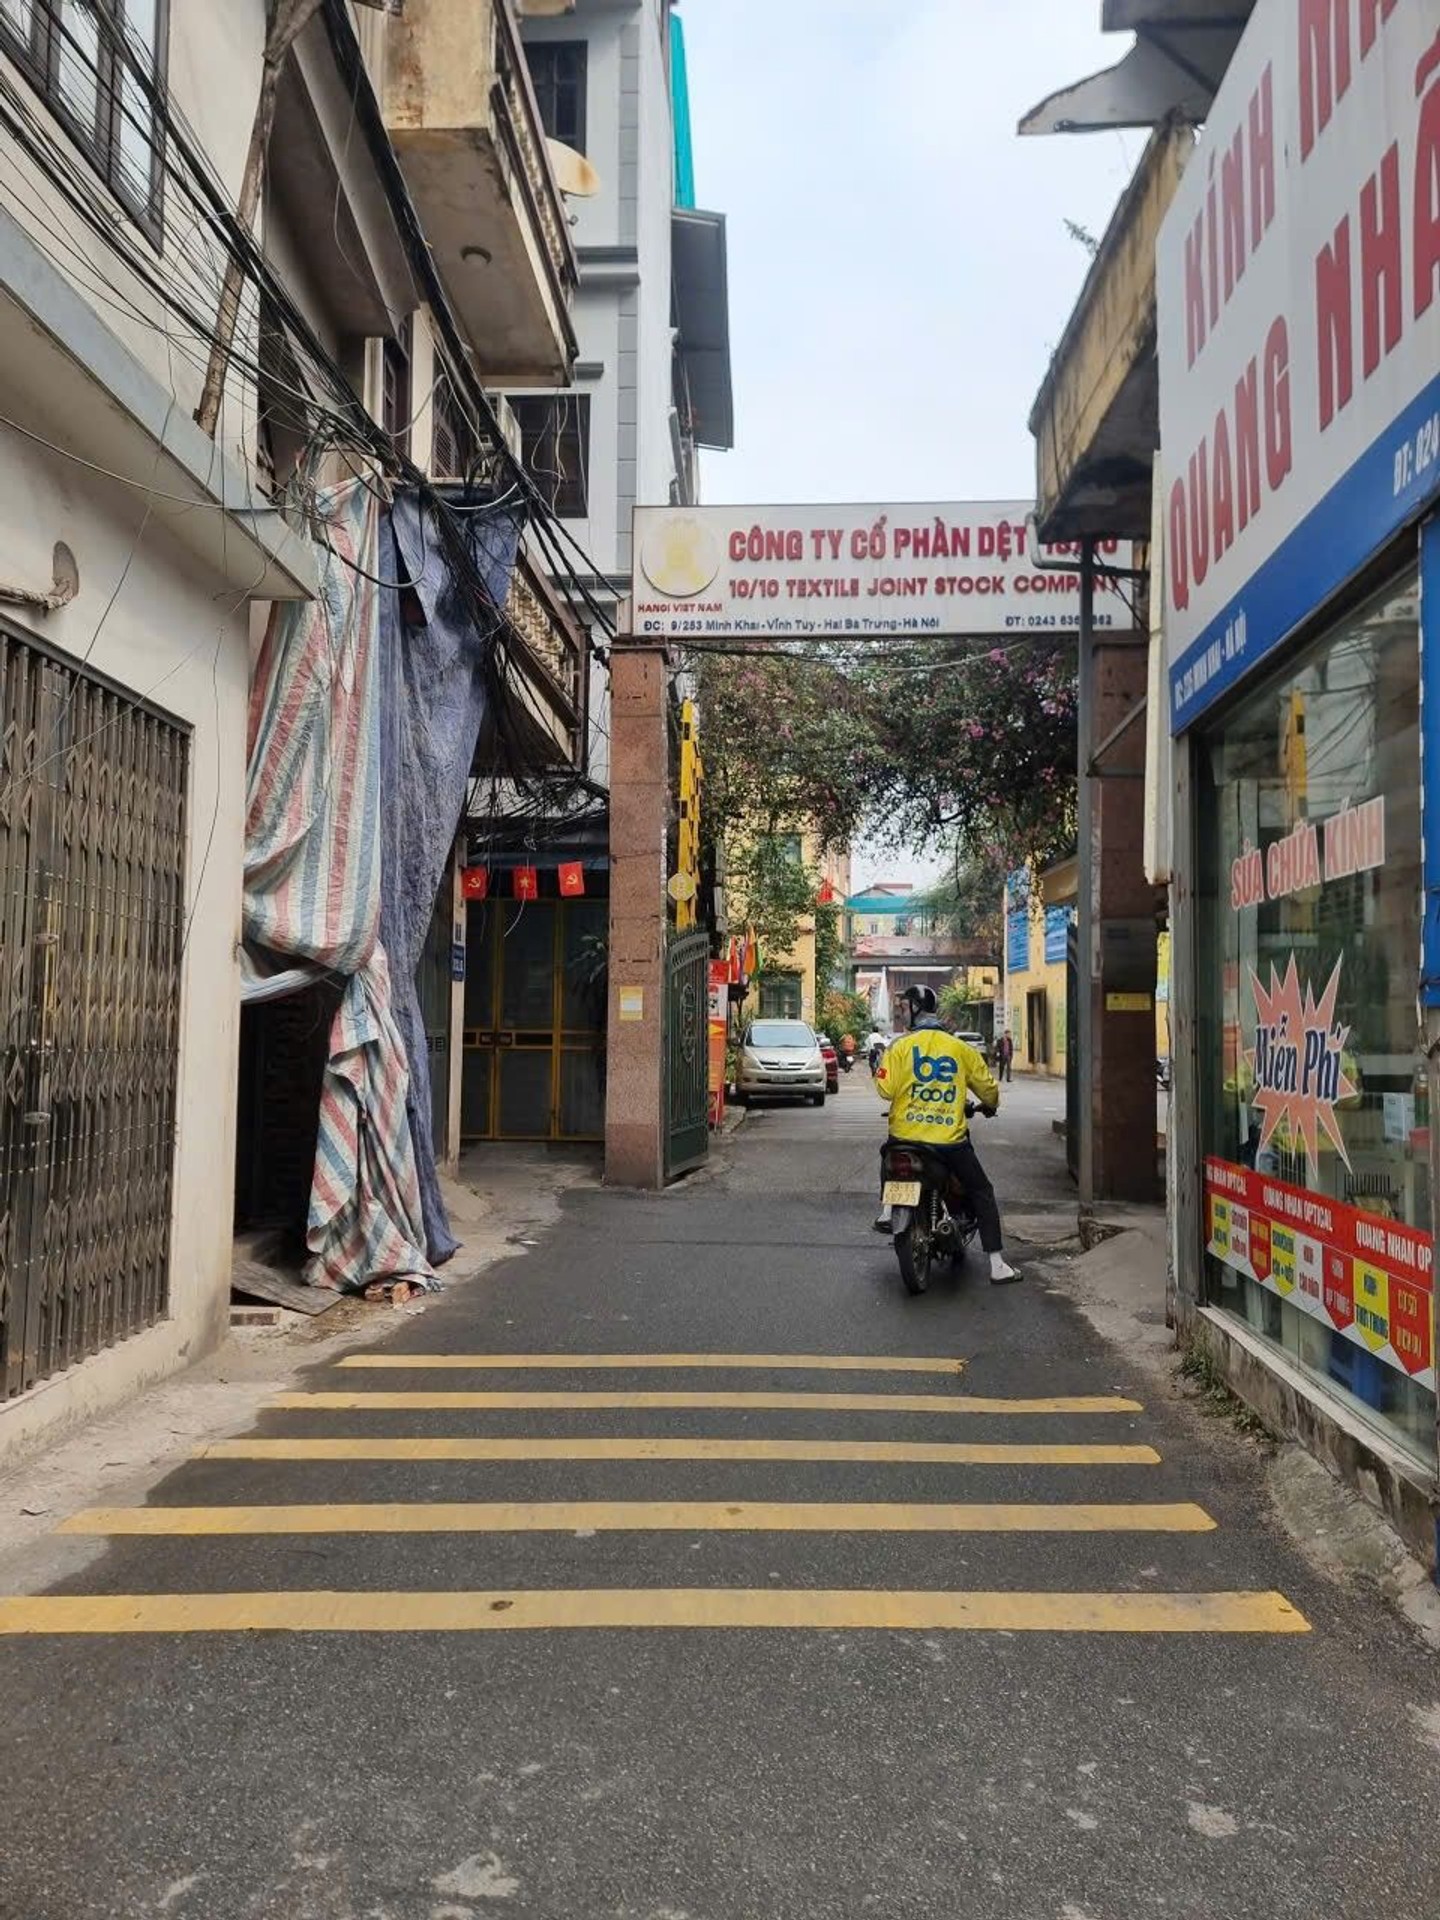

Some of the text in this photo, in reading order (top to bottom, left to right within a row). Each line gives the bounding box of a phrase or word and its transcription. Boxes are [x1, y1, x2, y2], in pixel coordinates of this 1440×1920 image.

[1185, 59, 1274, 373] KÍNH
[1170, 315, 1292, 611] QUANG
[729, 524, 803, 562] CÔNG
[810, 528, 844, 561] TY
[977, 520, 1028, 562] DỆT
[728, 575, 1118, 599] 10/10 TEXTILE JOINT STOCK COMPNY
[912, 1045, 958, 1083] be
[1253, 1013, 1342, 1102] Miễn Phí
[911, 1082, 957, 1104] Food
[1303, 1200, 1333, 1233] OPTICAL
[1356, 1220, 1386, 1255] QUANG
[1387, 1231, 1415, 1267] NHAN
